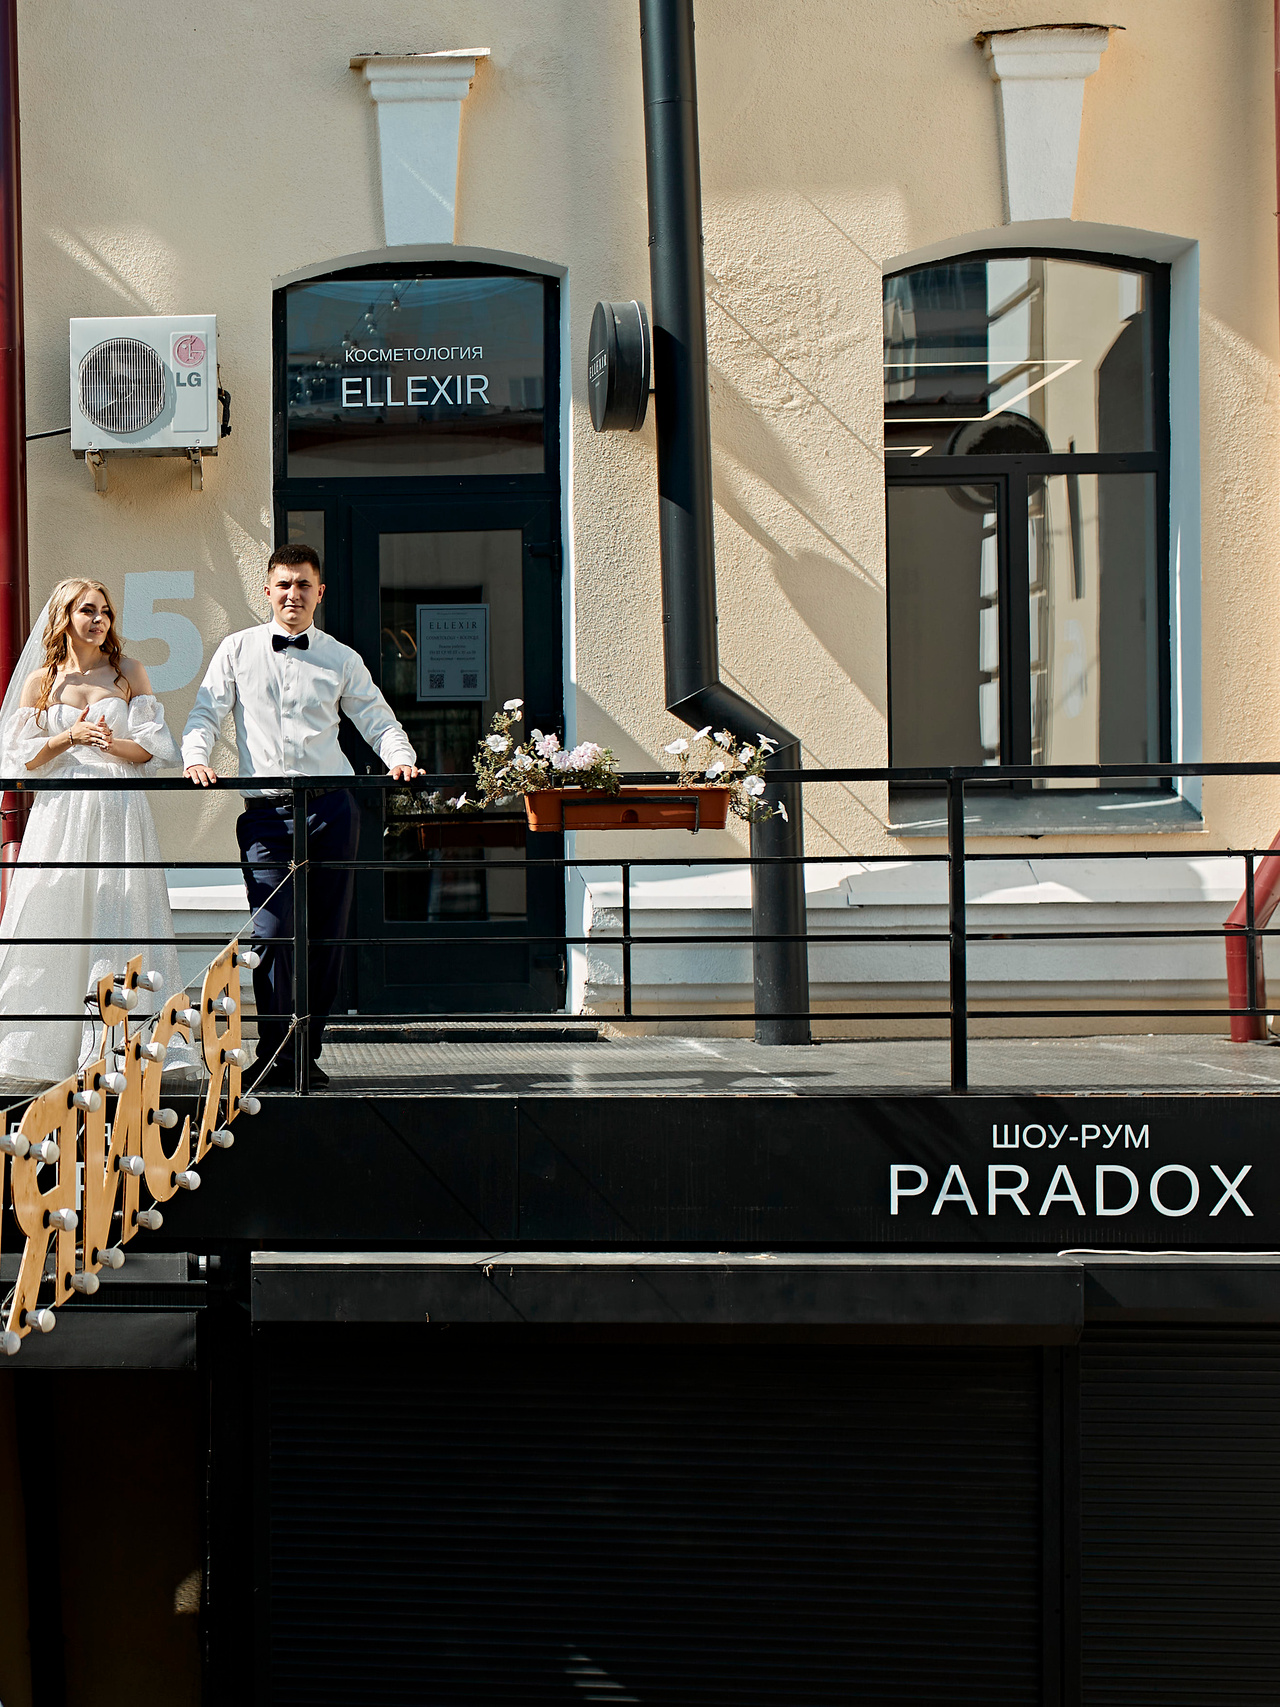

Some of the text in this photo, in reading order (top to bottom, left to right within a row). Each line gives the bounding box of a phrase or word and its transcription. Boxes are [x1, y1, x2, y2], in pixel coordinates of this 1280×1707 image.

[344, 346, 483, 363] КОСМЕТОЛОГИЯ
[589, 354, 607, 380] ELLEXIR
[175, 372, 202, 388] LG
[341, 374, 490, 408] ELLEXIR
[122, 570, 204, 694] 5
[429, 621, 478, 630] ELLEXIR
[992, 1124, 1150, 1149] ШОУ-РУМ
[889, 1164, 1255, 1218] PARADOX
